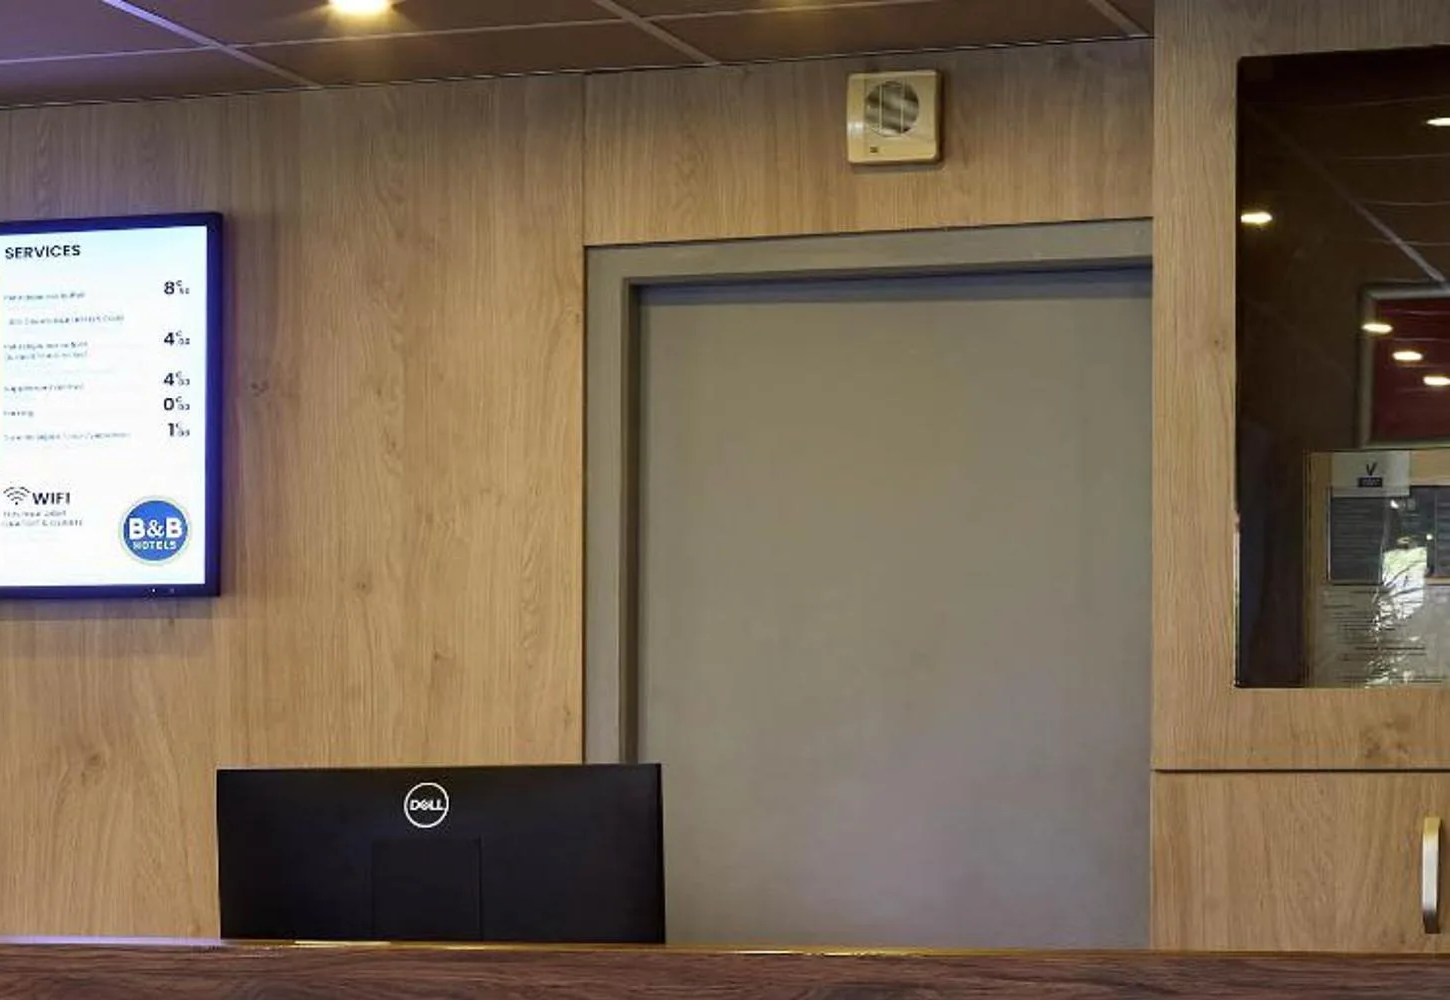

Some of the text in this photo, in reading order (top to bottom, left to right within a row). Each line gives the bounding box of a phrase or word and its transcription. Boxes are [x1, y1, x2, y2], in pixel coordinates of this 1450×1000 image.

[5, 244, 81, 259] SERVICES
[32, 491, 71, 505] WIFI
[129, 516, 183, 540] B&B
[132, 540, 177, 550] HOTELS
[410, 798, 445, 811] DELL
